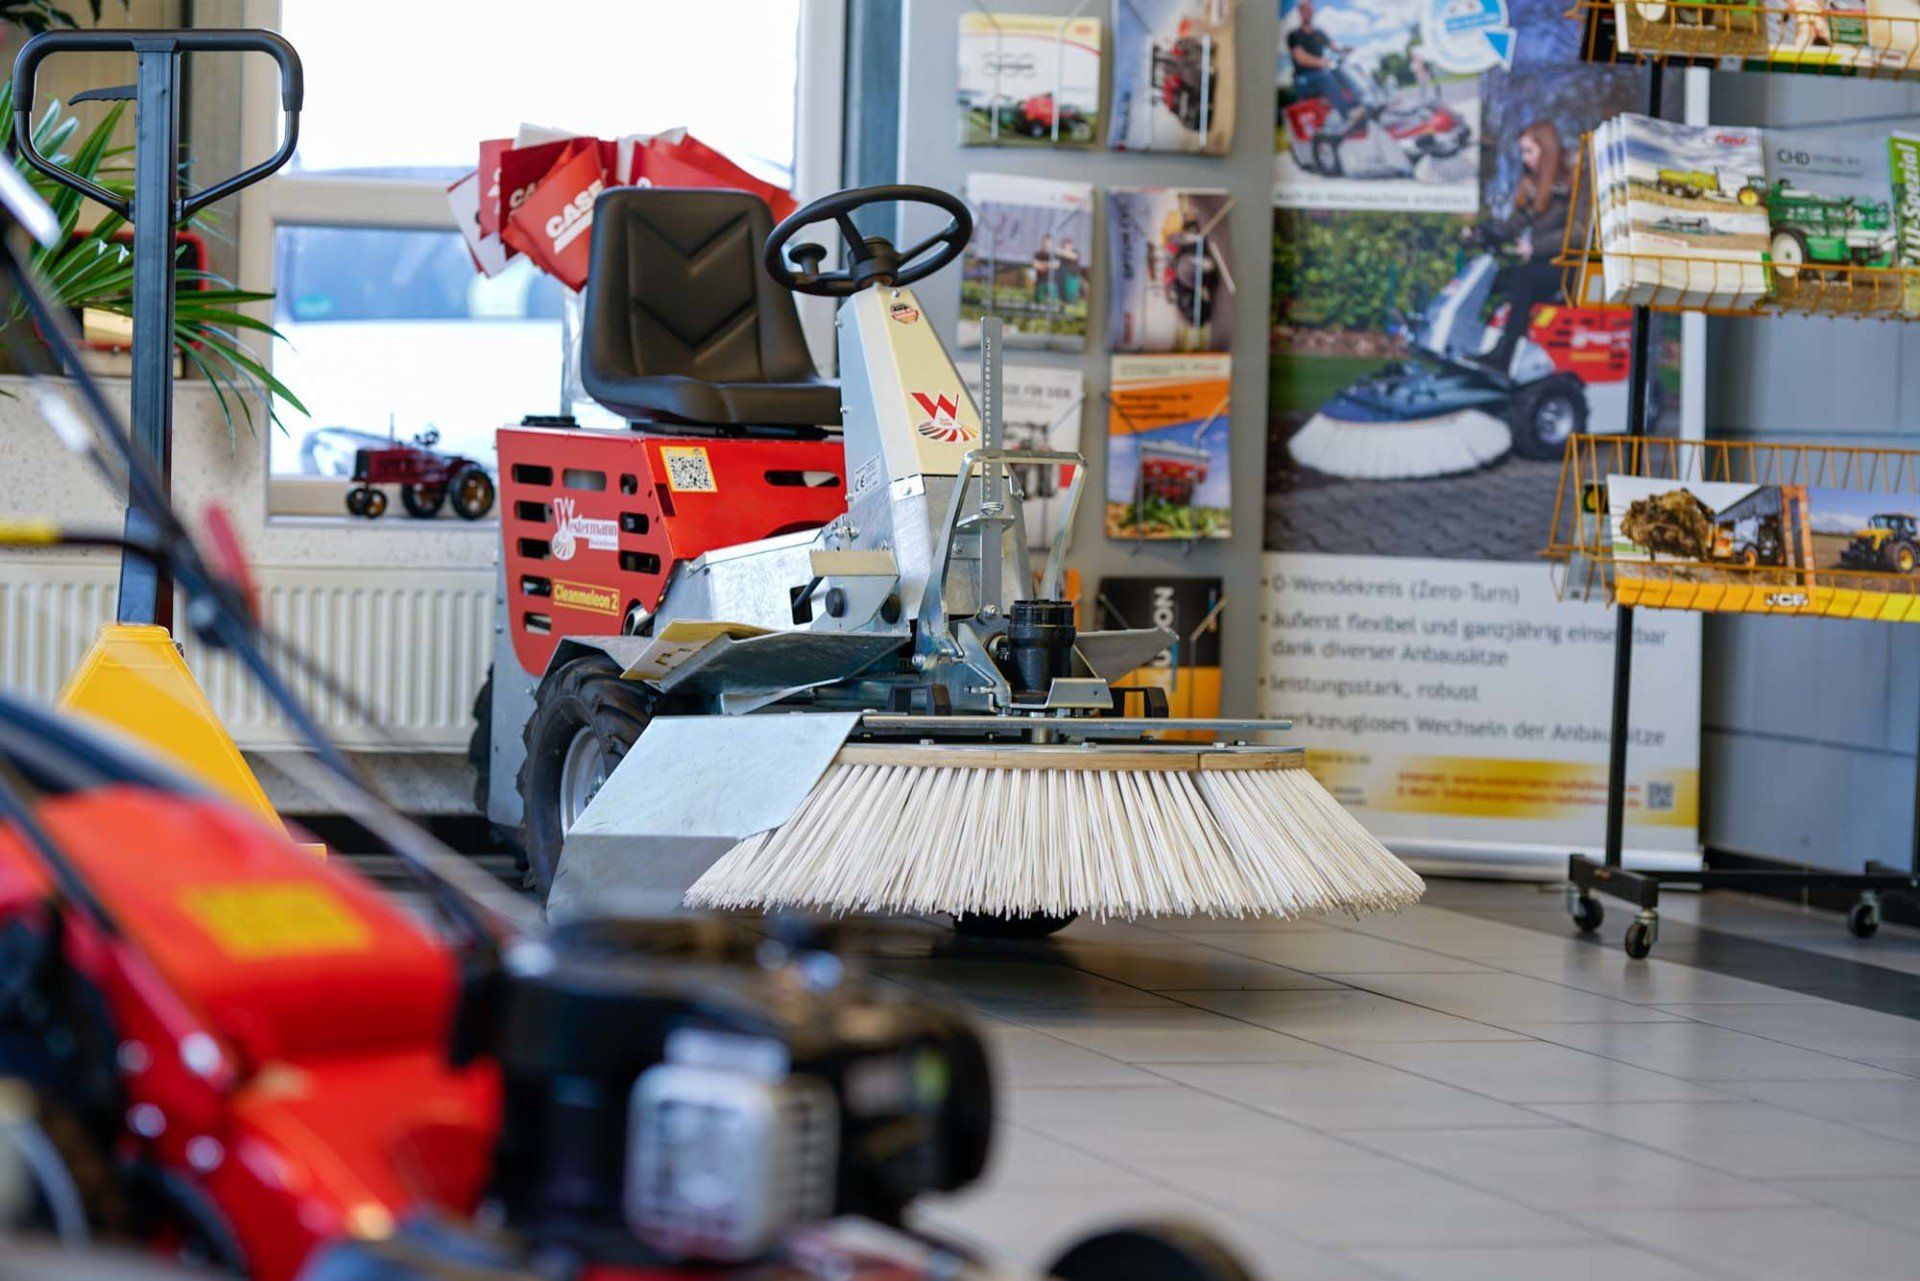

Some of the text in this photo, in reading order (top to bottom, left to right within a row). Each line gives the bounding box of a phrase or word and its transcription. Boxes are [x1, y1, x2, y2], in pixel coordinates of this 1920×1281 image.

[1421, 615, 1458, 635] und
[1271, 638, 1315, 658] dank
[1320, 641, 1395, 661] diverser
[1416, 680, 1479, 701] robust
[1416, 715, 1507, 739] Wechseln
[1513, 718, 1545, 740] der
